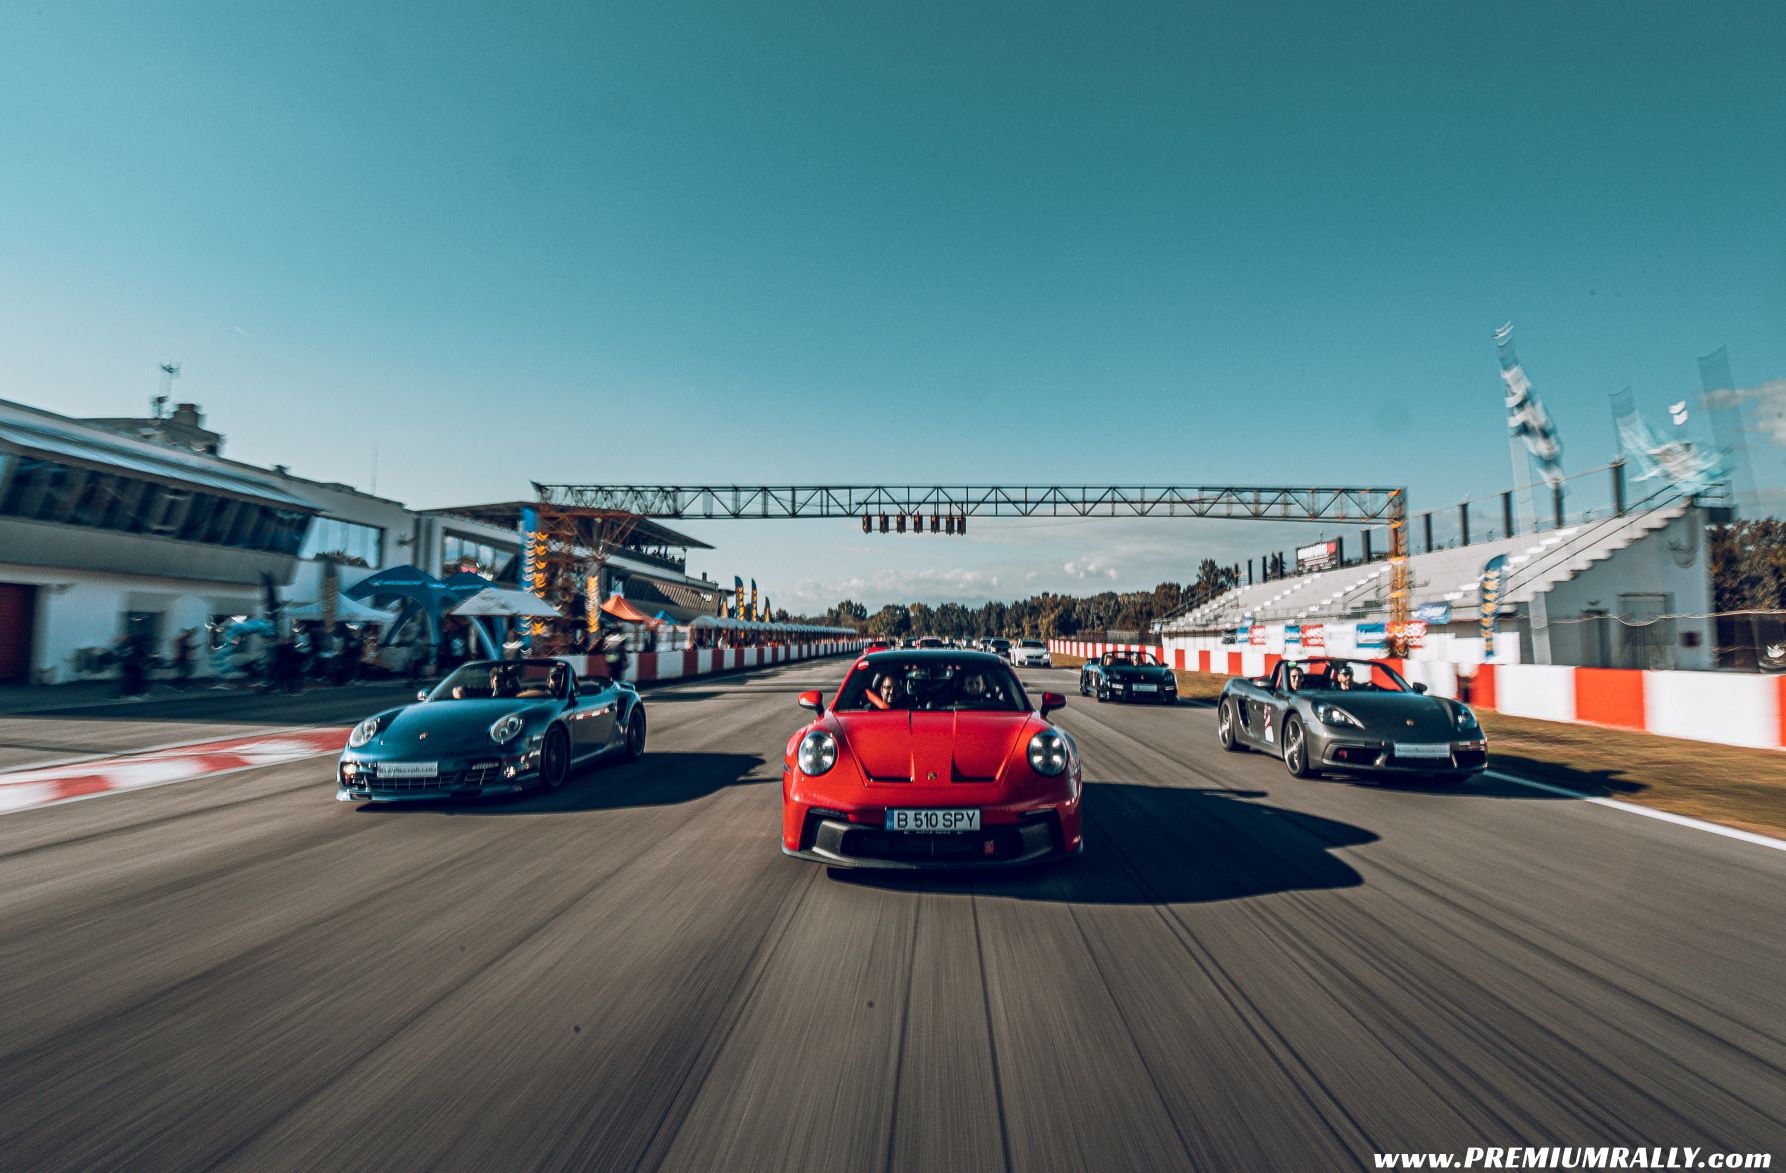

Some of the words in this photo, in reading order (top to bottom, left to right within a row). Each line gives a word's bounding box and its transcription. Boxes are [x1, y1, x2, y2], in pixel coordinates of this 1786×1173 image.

[897, 812, 908, 828] B
[914, 812, 938, 828] 510
[942, 812, 976, 828] SPY
